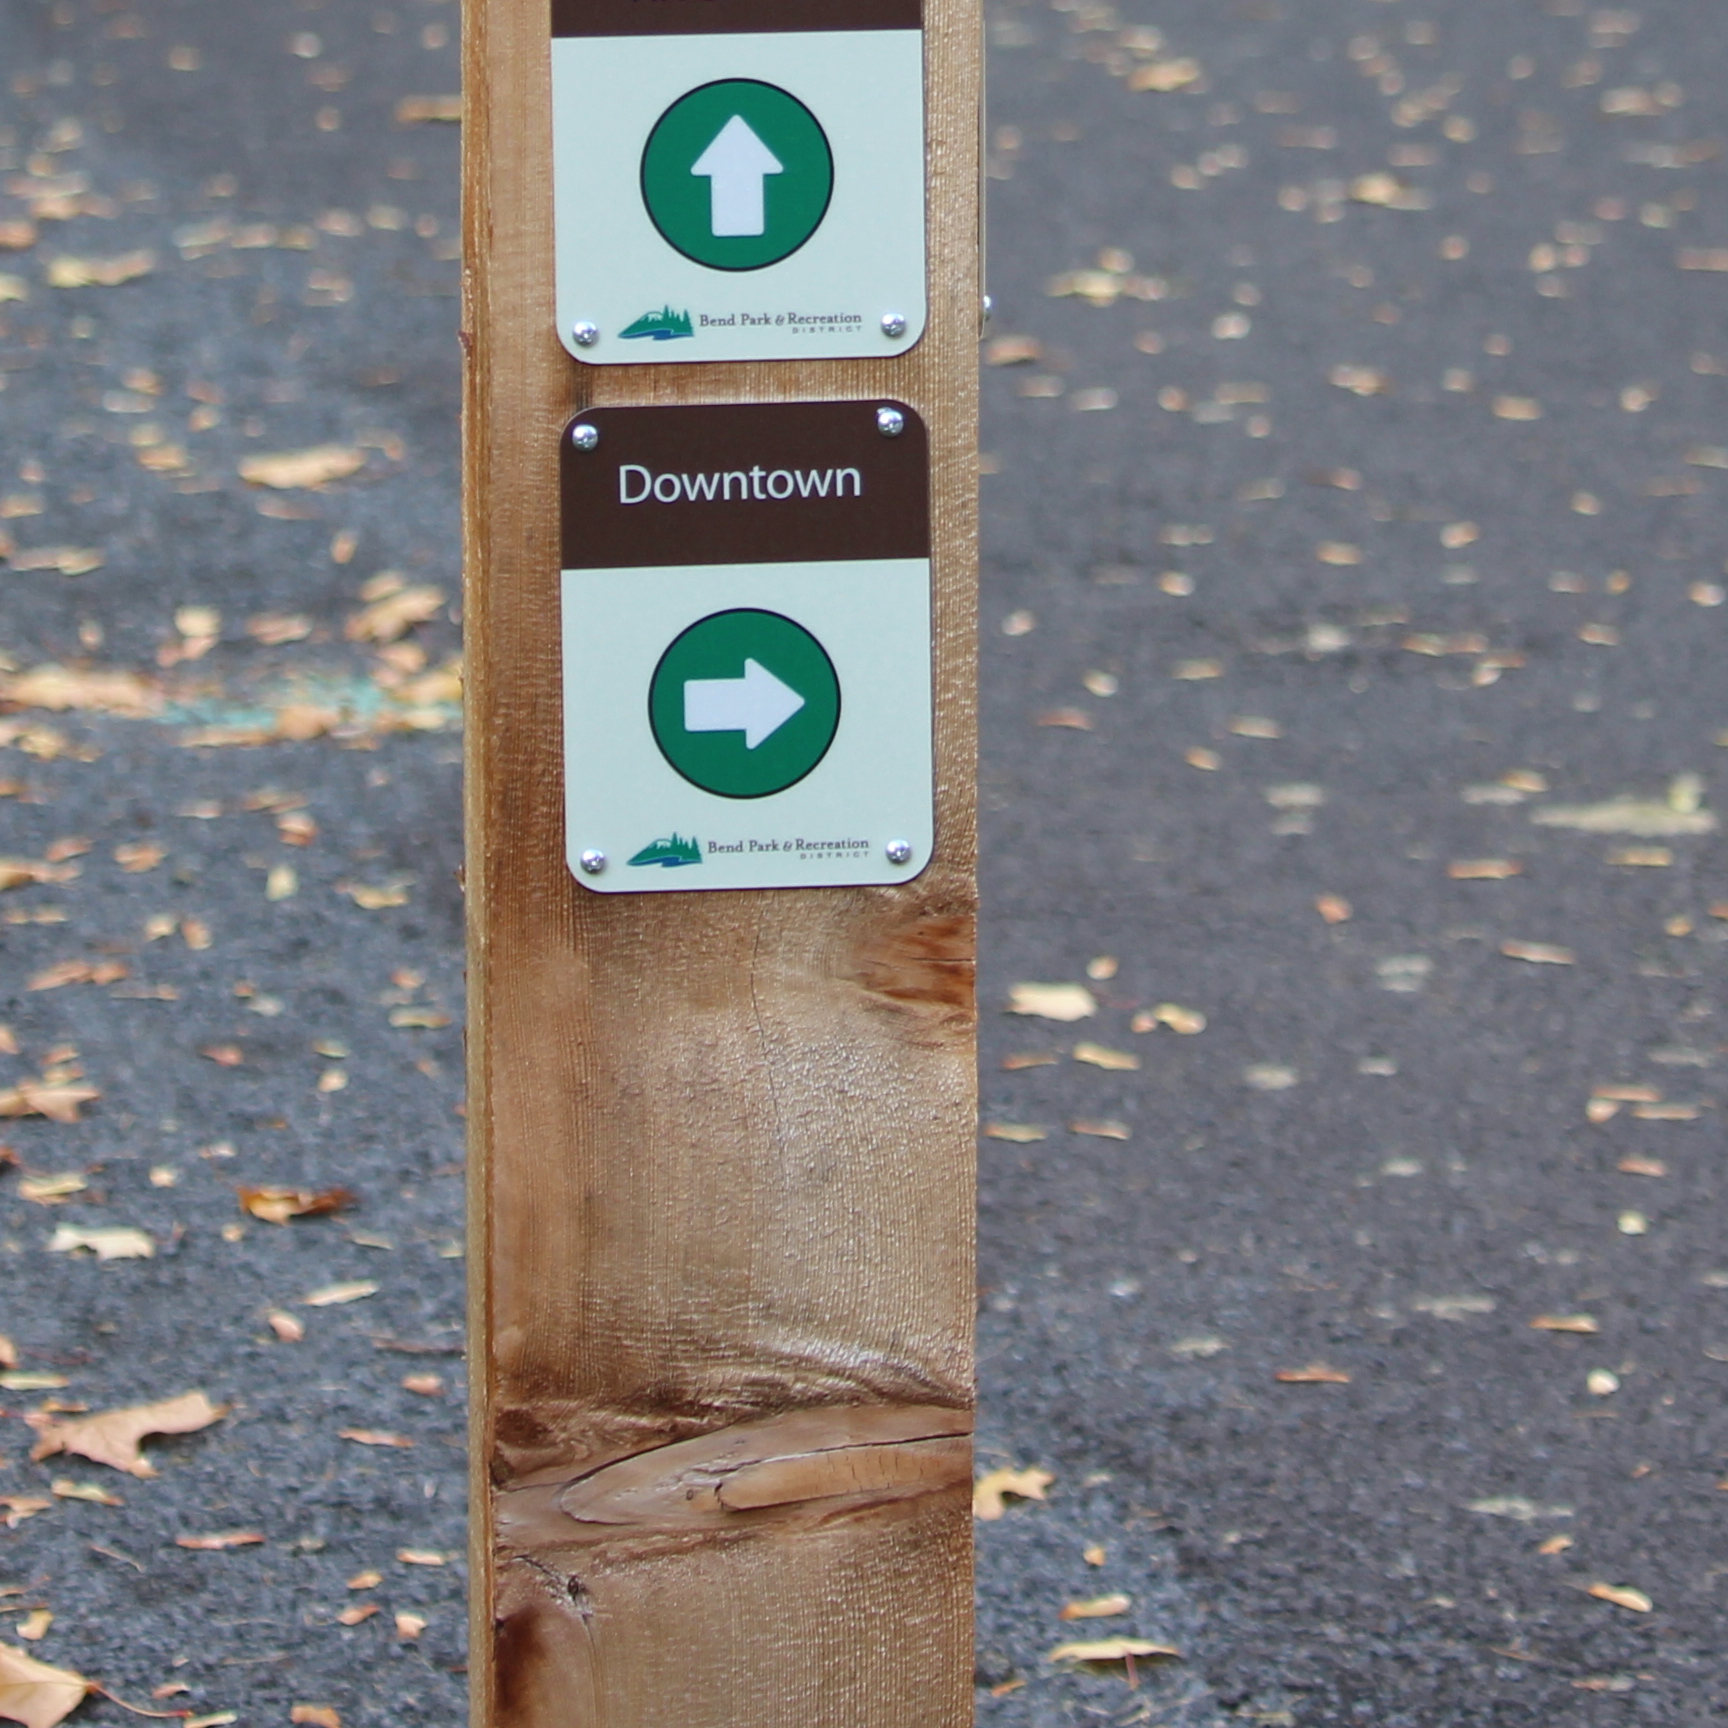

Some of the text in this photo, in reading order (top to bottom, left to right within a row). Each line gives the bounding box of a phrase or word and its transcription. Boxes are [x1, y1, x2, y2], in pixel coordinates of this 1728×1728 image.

[700, 311, 862, 327] Bend Park & Recreation
[791, 325, 862, 334] DISTRICT
[619, 464, 862, 504] Downtown
[707, 838, 870, 854] Bend Park & Recreation
[800, 851, 870, 860] DISTRICT
